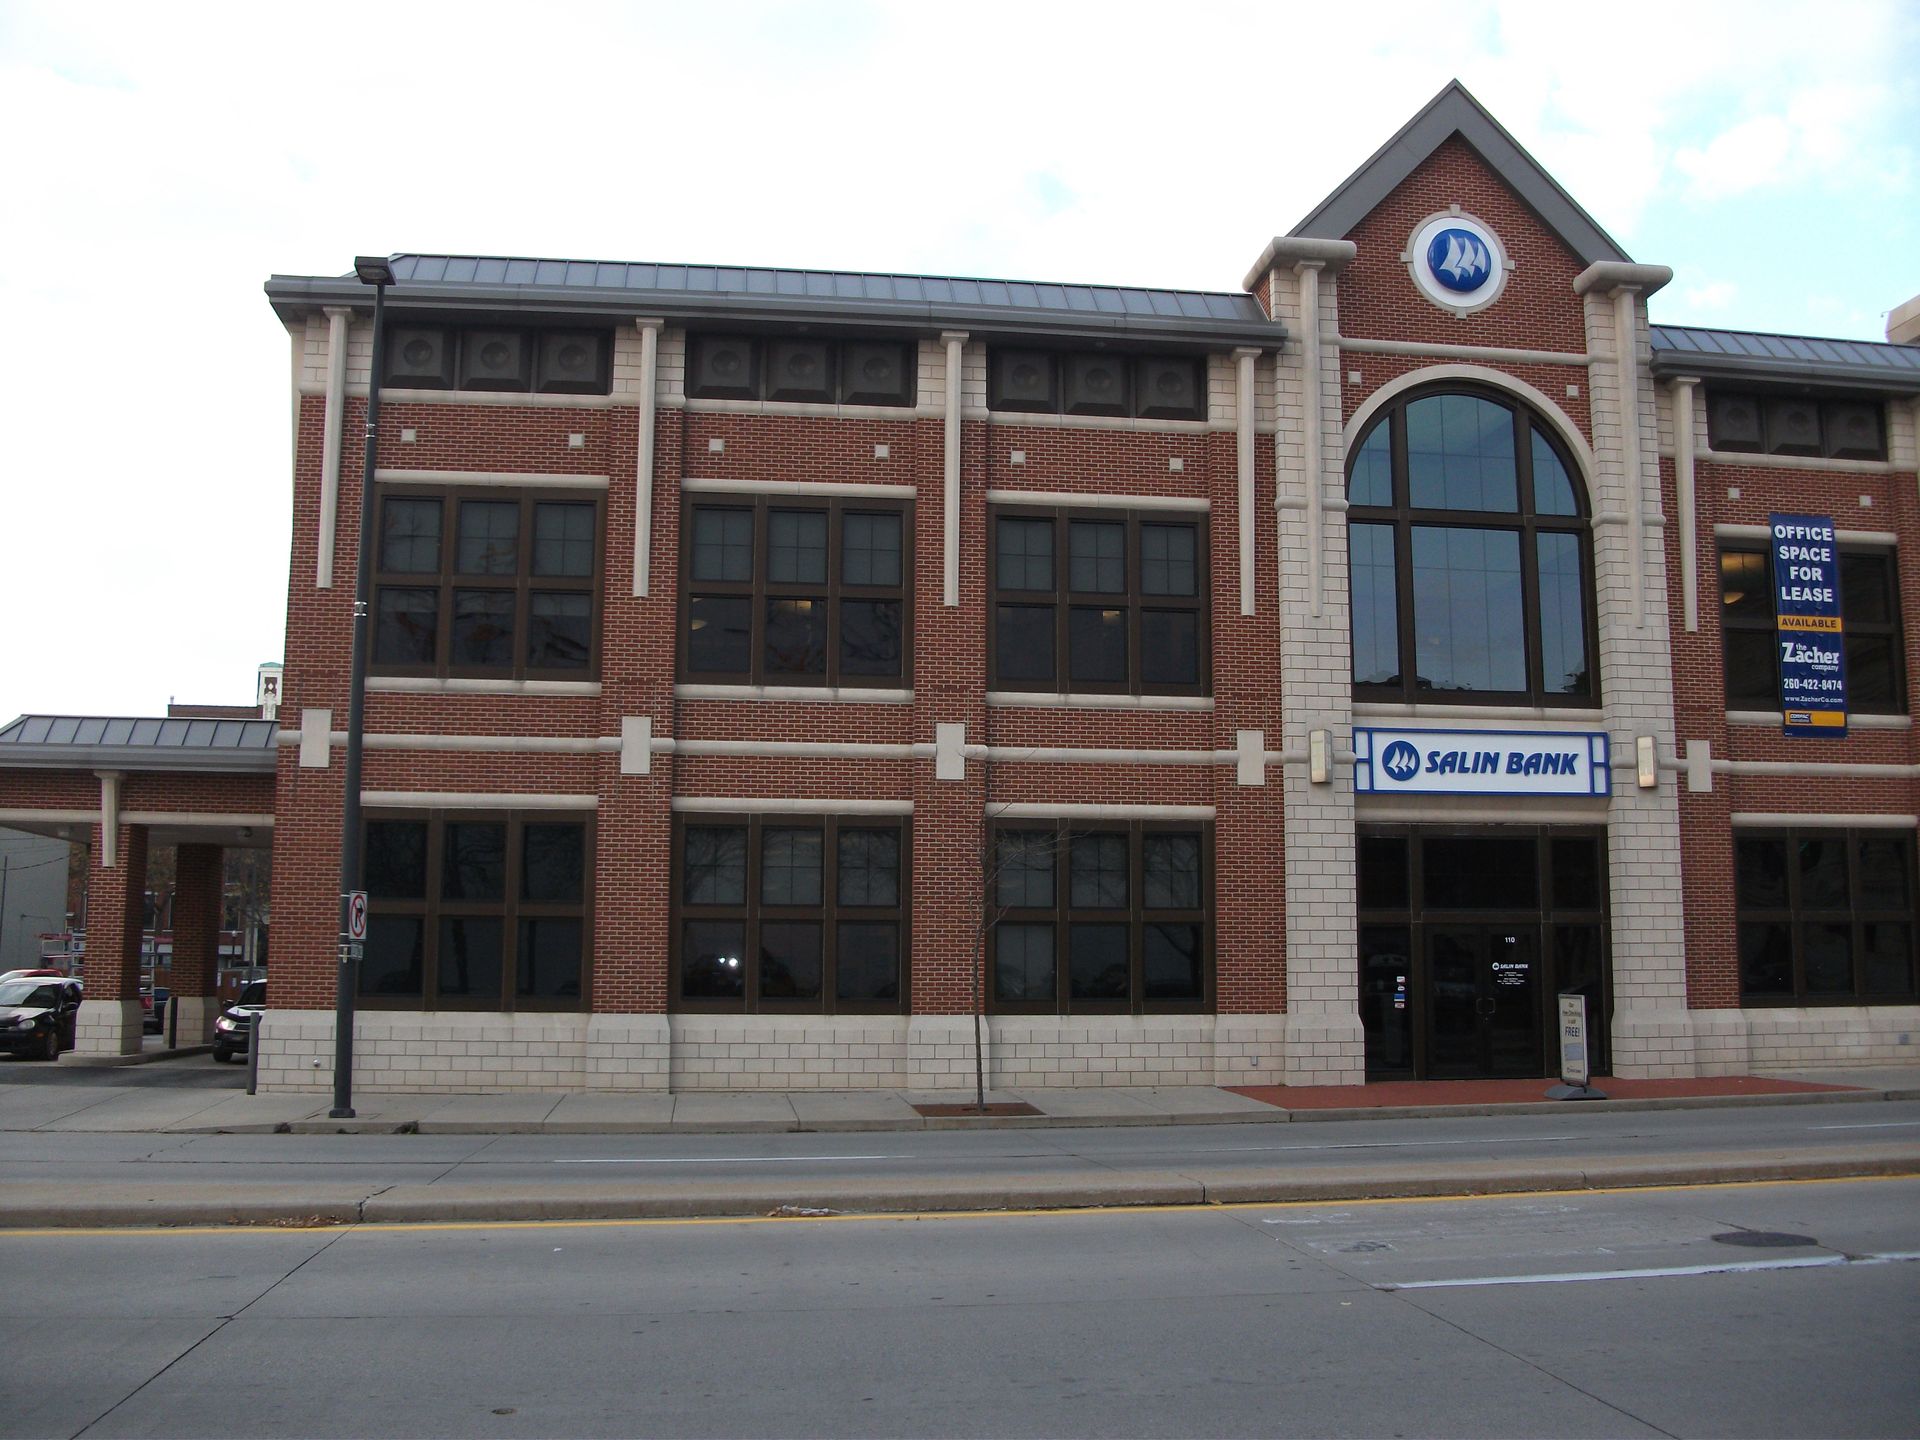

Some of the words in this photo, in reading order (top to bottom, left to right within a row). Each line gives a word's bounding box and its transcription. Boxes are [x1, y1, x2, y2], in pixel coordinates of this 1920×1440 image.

[1774, 525, 1832, 541] OFFICE
[1779, 546, 1831, 562] SPACE
[1789, 566, 1823, 581] FOR
[1781, 586, 1833, 602] LEASE
[1781, 617, 1837, 628] AVAILABLE
[1781, 642, 1840, 664] Zacher
[1795, 643, 1807, 651] the
[1811, 664, 1839, 672] company
[1783, 678, 1843, 691] 260-422-8474
[1784, 695, 1844, 703] www.ZacherCo.com
[1425, 751, 1500, 775] SALIN
[1506, 752, 1579, 777] BANK
[1565, 1026, 1580, 1038] FREE!
